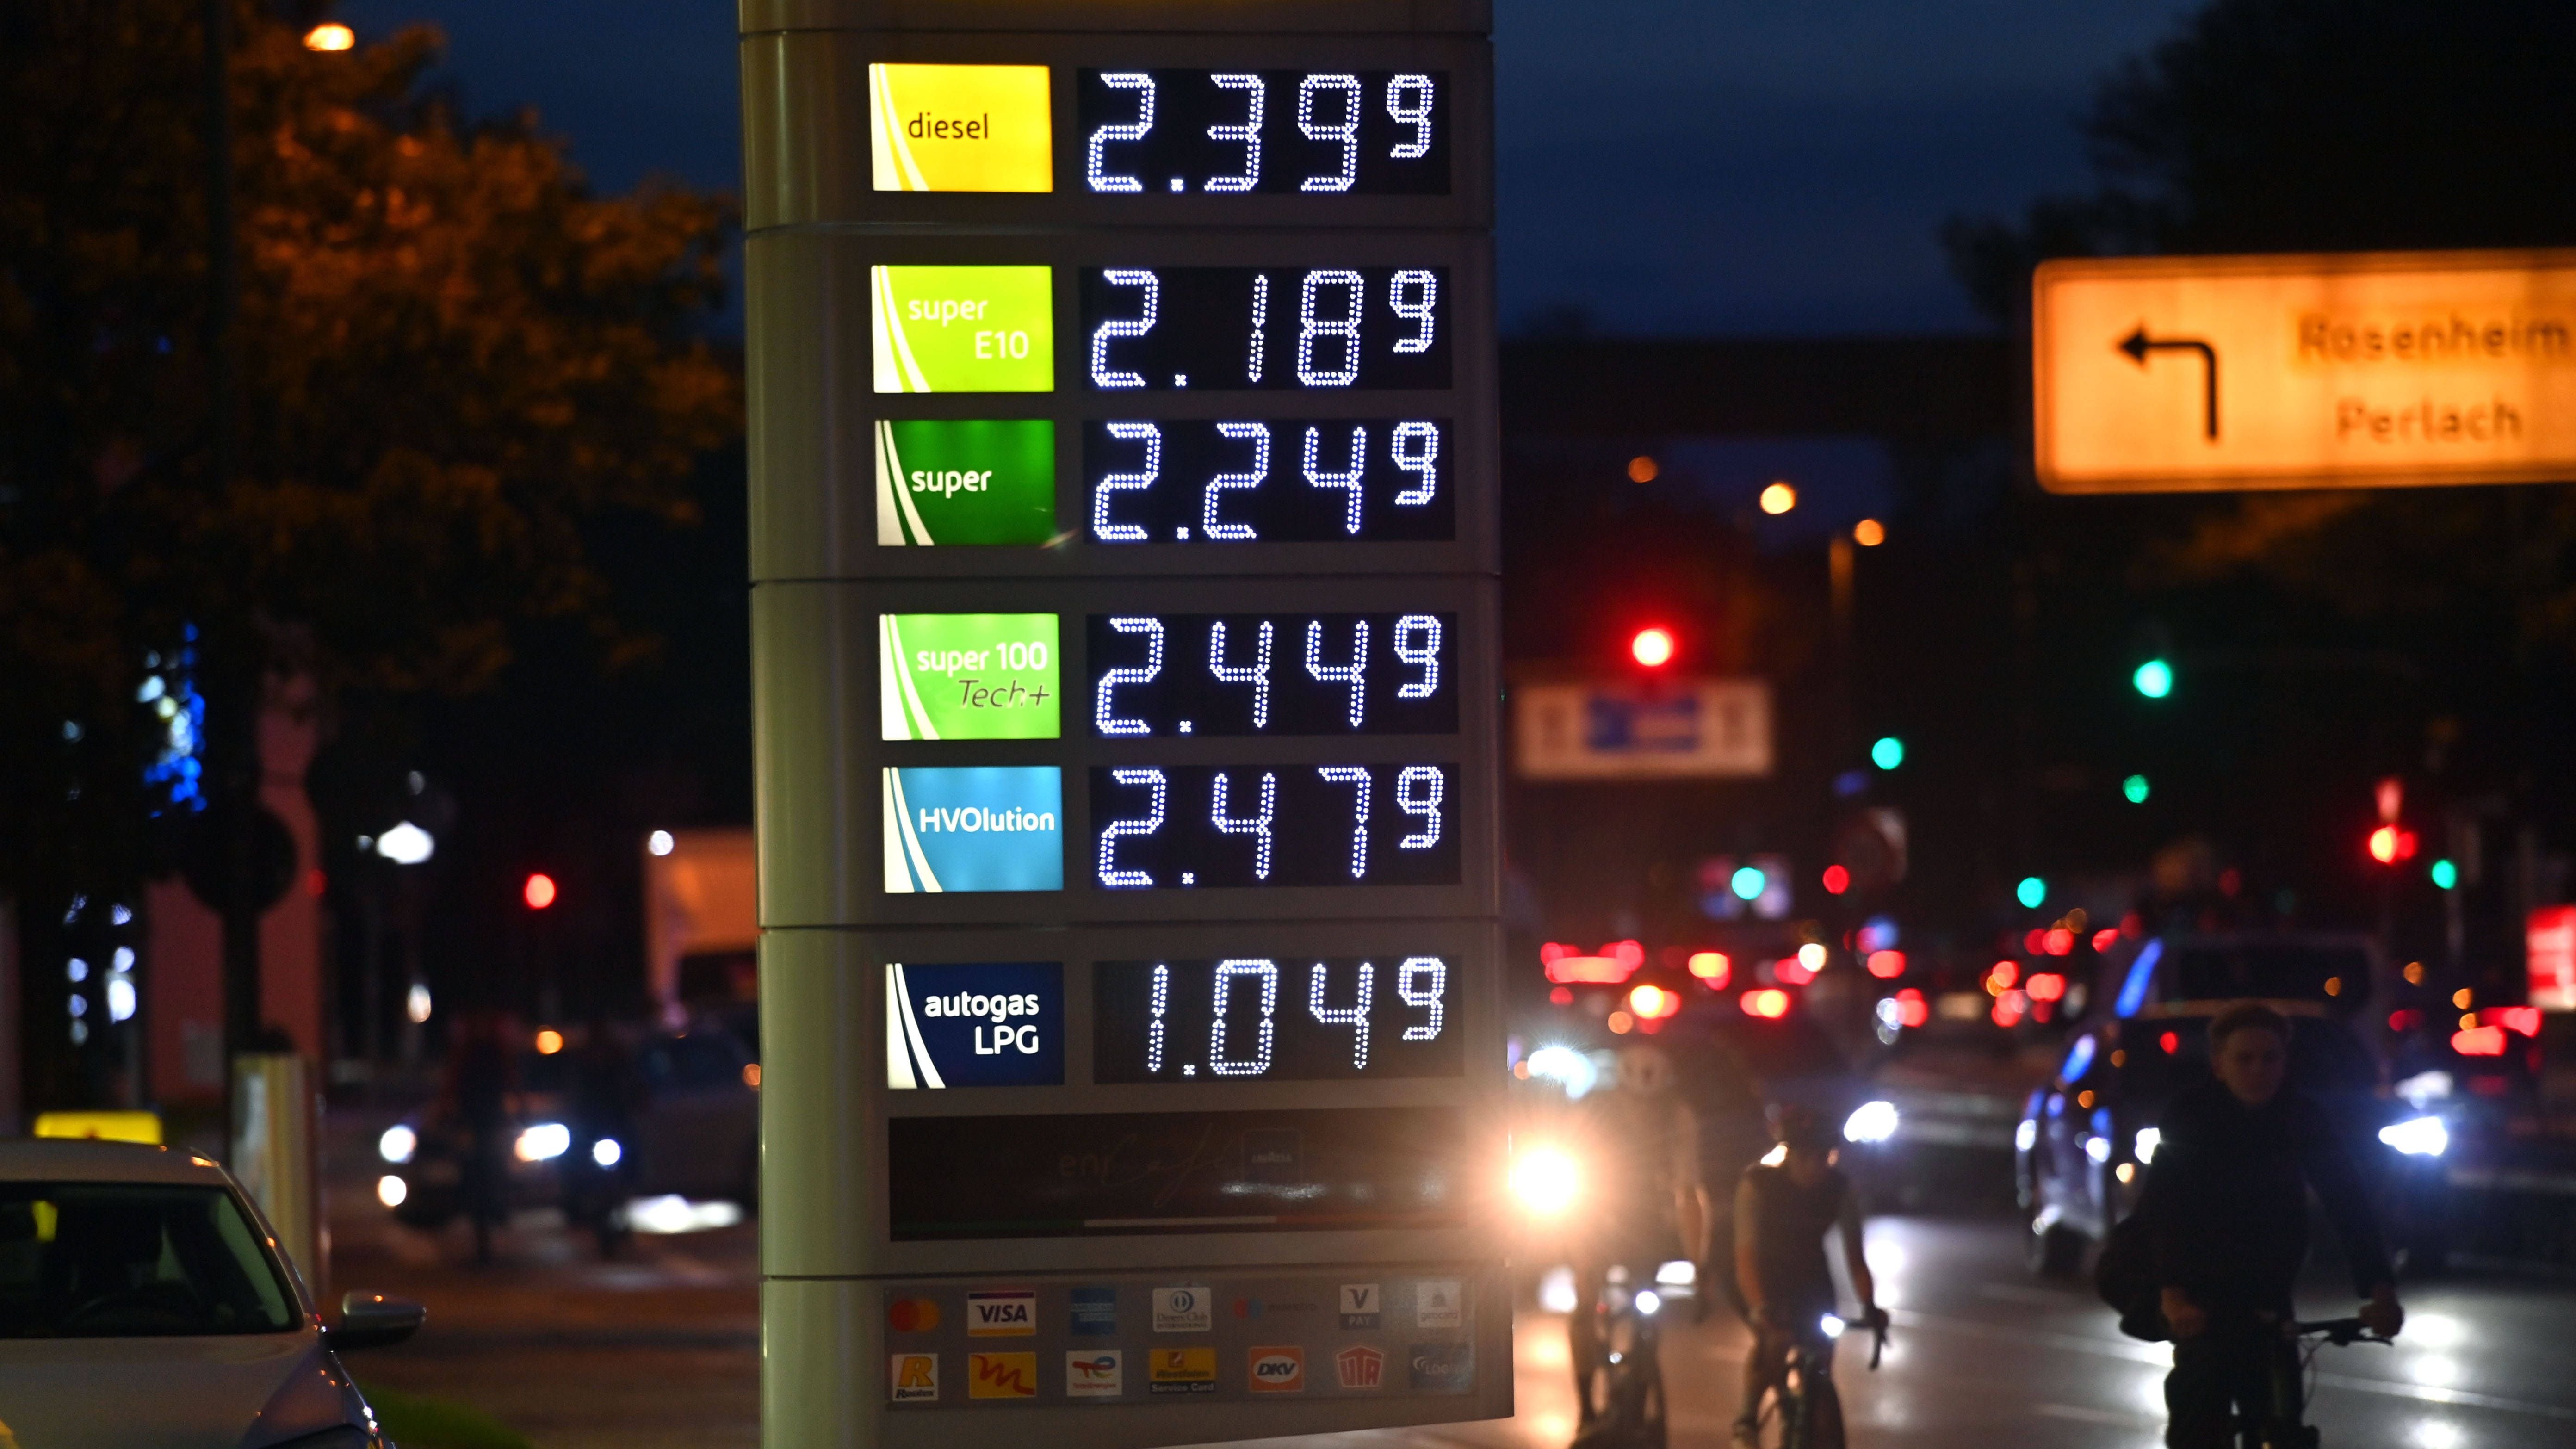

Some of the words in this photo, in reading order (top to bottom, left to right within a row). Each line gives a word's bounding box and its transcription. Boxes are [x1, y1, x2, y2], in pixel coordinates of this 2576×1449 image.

[908, 113, 989, 139] diesel
[908, 299, 989, 328] super
[975, 330, 1029, 359] E10
[2335, 394, 2523, 444] Perlach
[911, 469, 992, 498] super
[916, 650, 989, 678] super
[996, 640, 1049, 671] 100
[958, 680, 1051, 708] Tech+
[919, 806, 1055, 833] HVOlution
[924, 990, 1040, 1023] autogas
[974, 1024, 1039, 1055] LPG
[976, 1303, 1028, 1322] VISA
[1348, 1289, 1369, 1309] V
[1256, 1362, 1295, 1376] DKV
